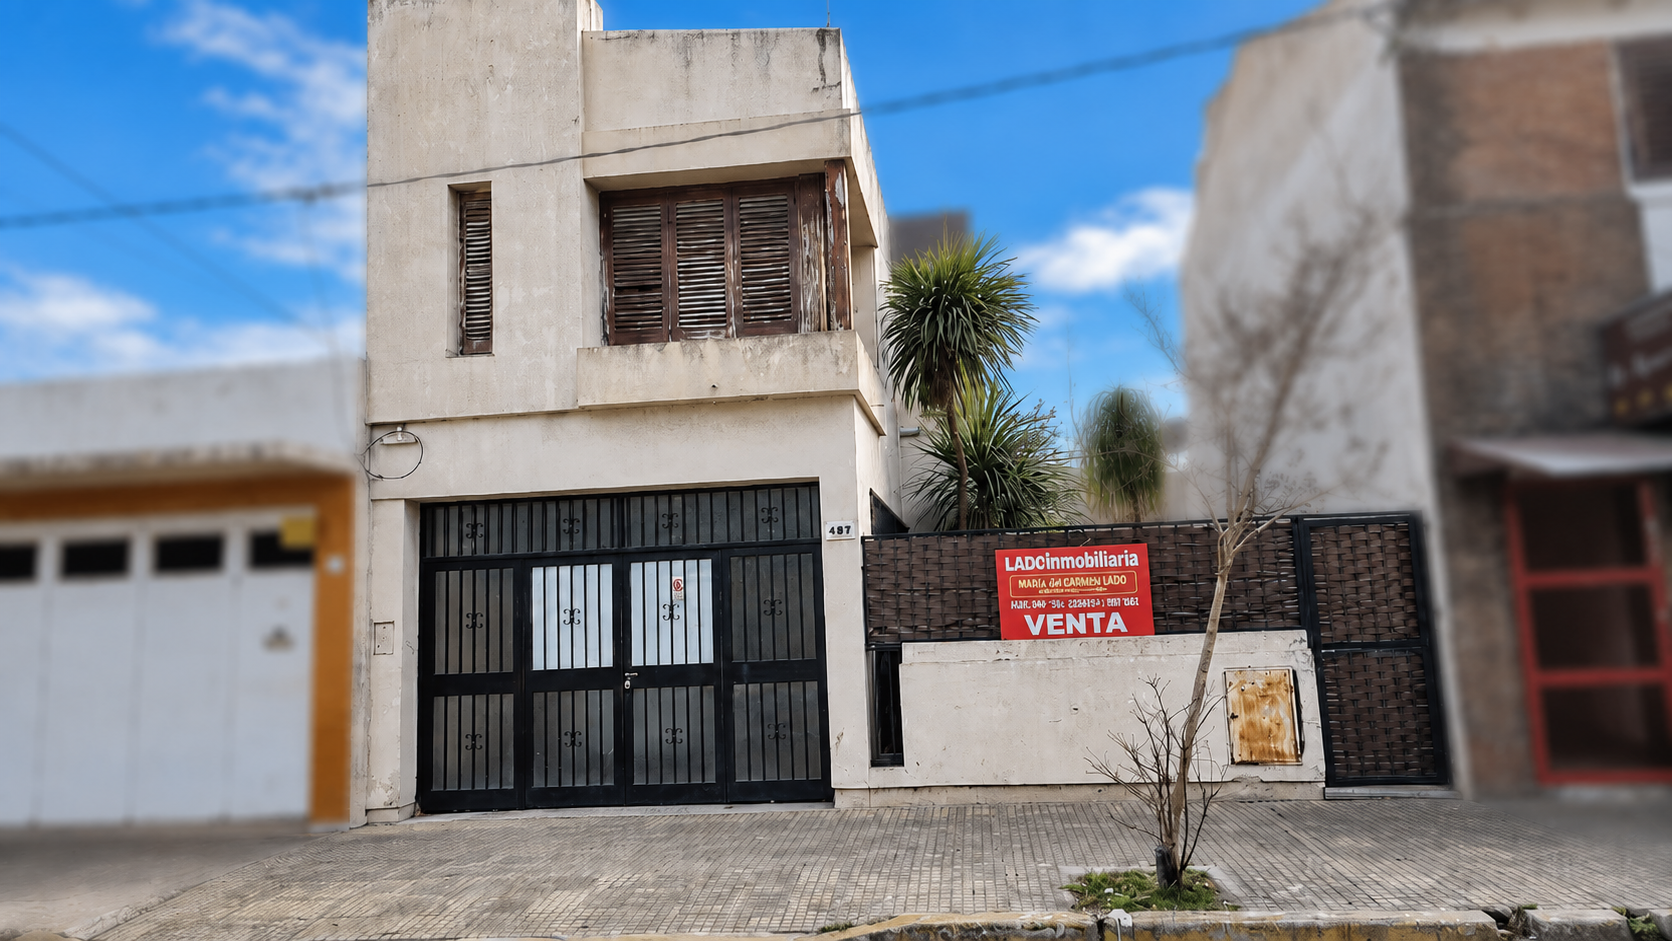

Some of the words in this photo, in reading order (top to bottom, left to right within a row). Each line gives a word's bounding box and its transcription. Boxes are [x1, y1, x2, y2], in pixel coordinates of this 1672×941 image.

[829, 525, 851, 535] 487
[1102, 574, 1127, 585] LADO
[1024, 611, 1128, 635] VENTA
